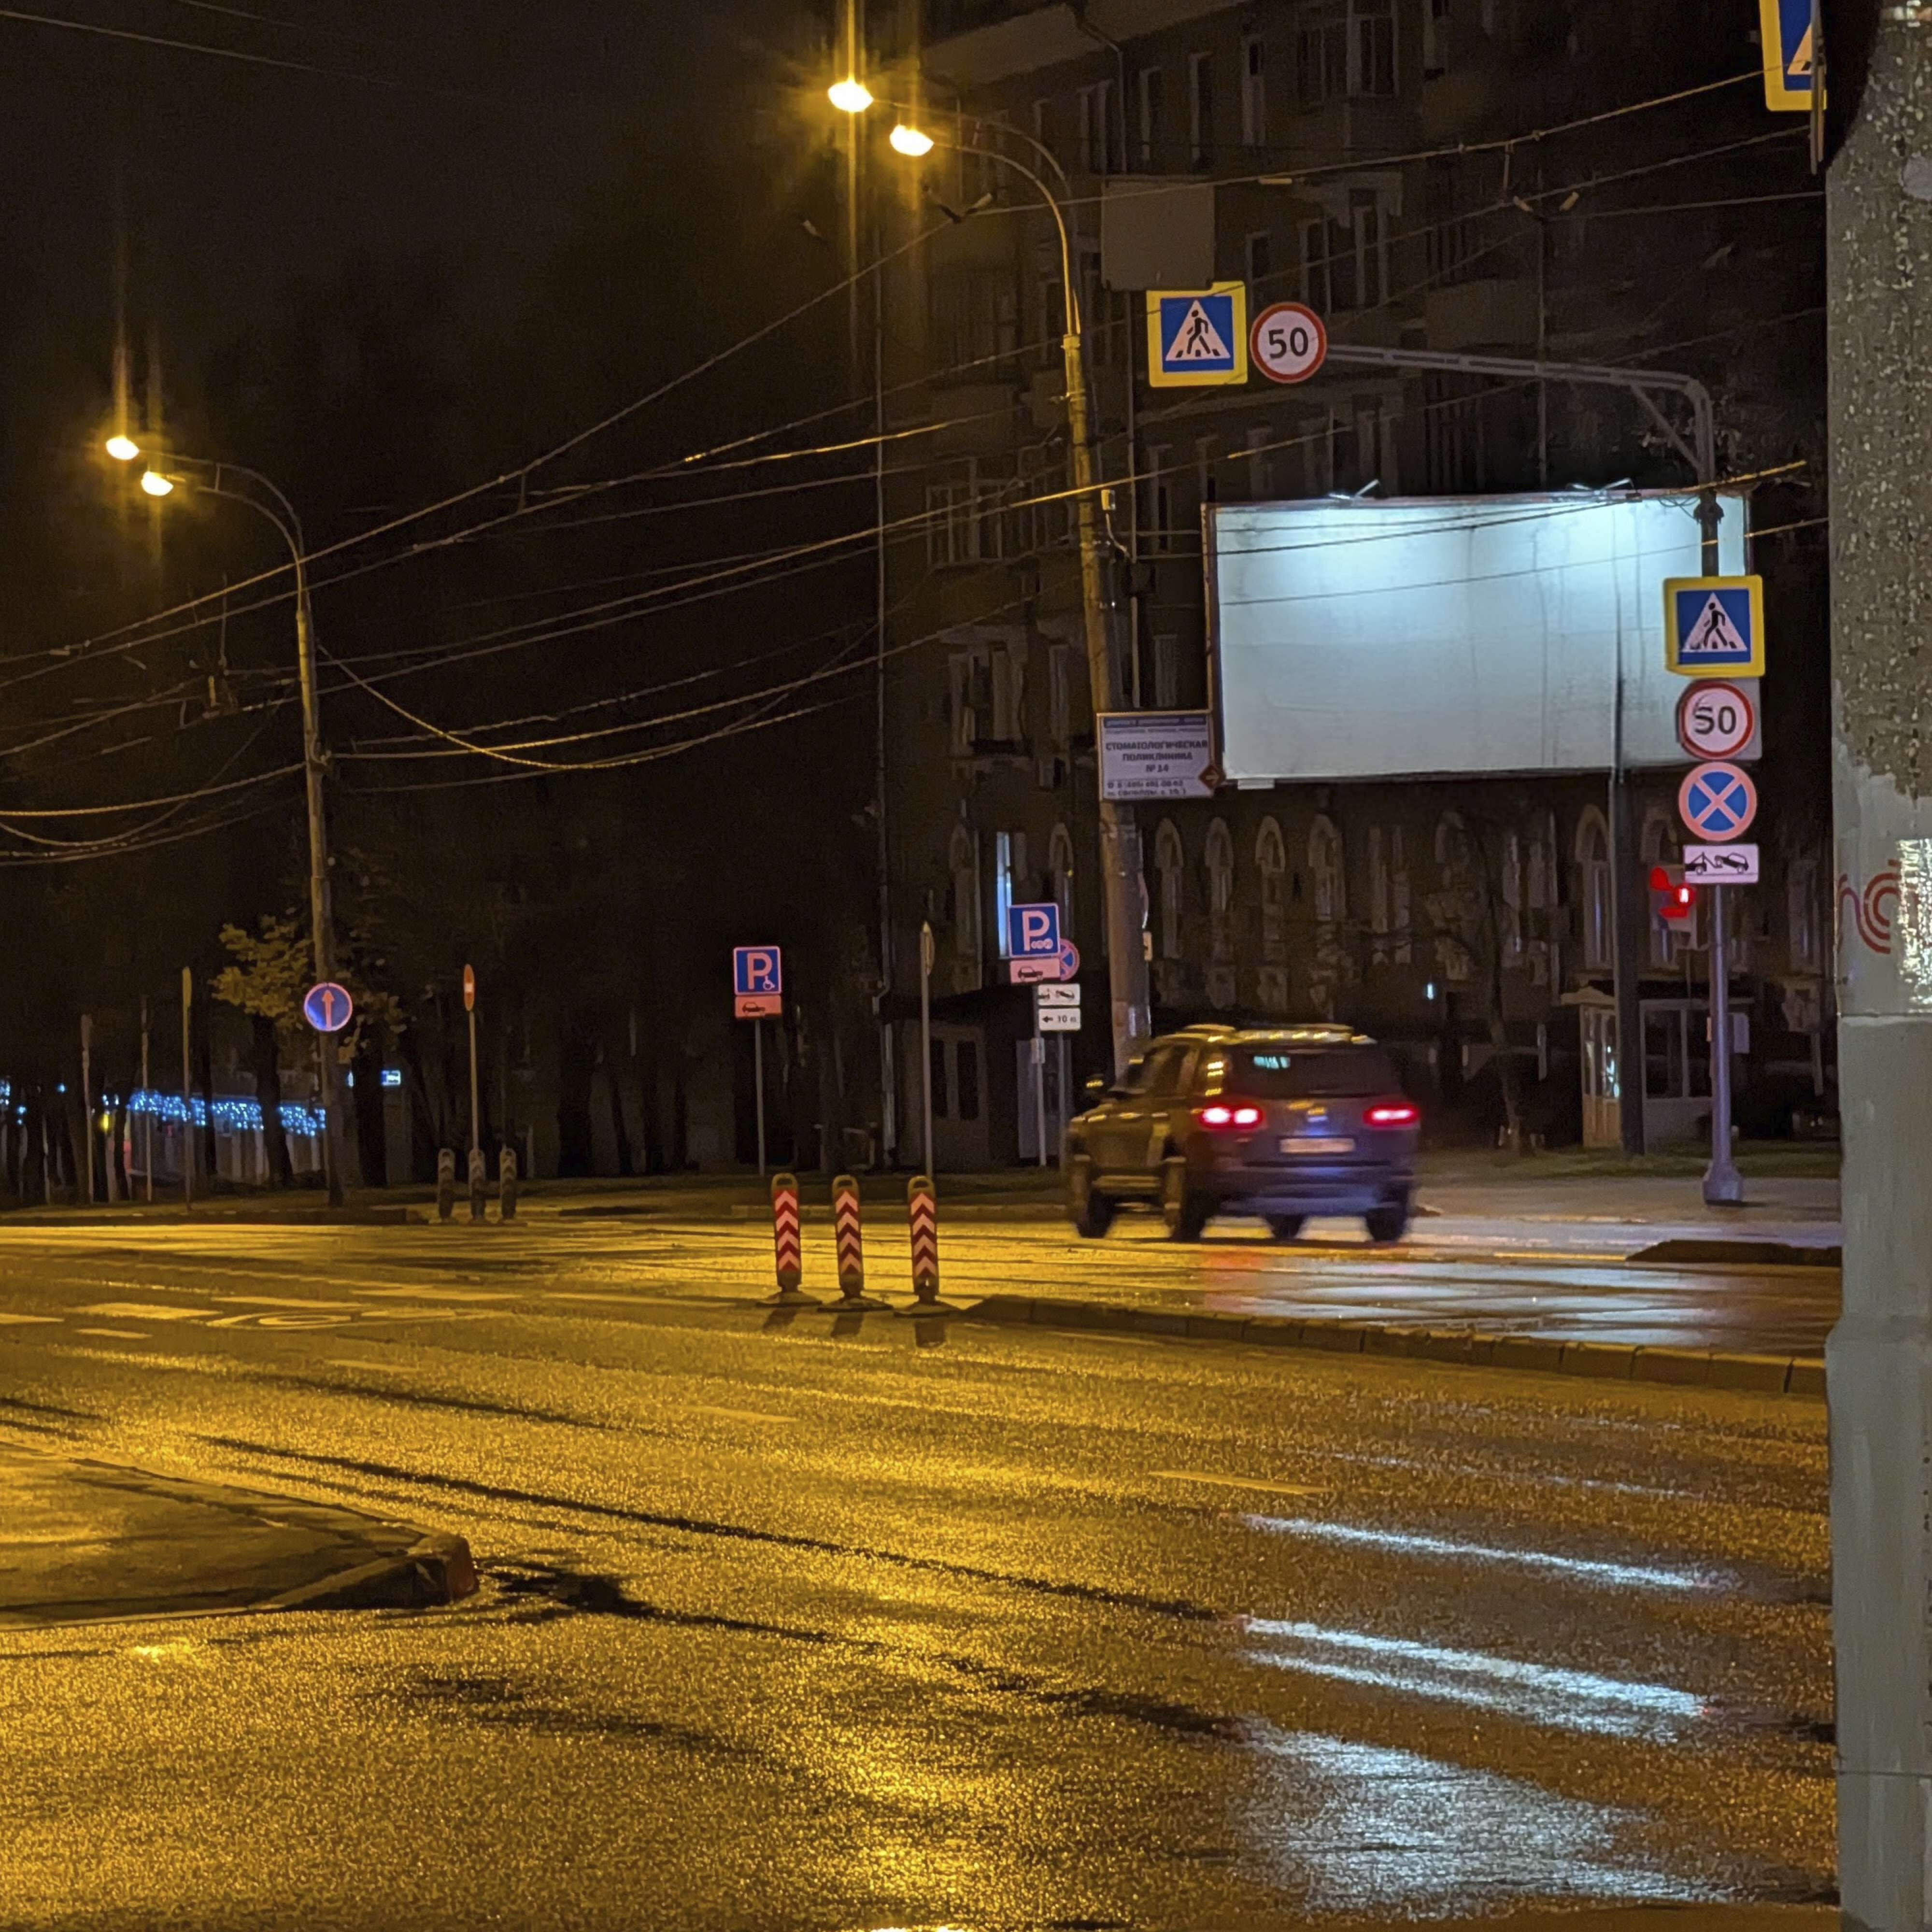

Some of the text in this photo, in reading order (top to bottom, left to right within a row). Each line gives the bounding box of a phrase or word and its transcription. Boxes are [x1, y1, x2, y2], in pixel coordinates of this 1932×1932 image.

[1268, 327, 1308, 359] 50
[1694, 706, 1736, 735] 50
[1022, 910, 1050, 951] P
[747, 952, 772, 989] P
